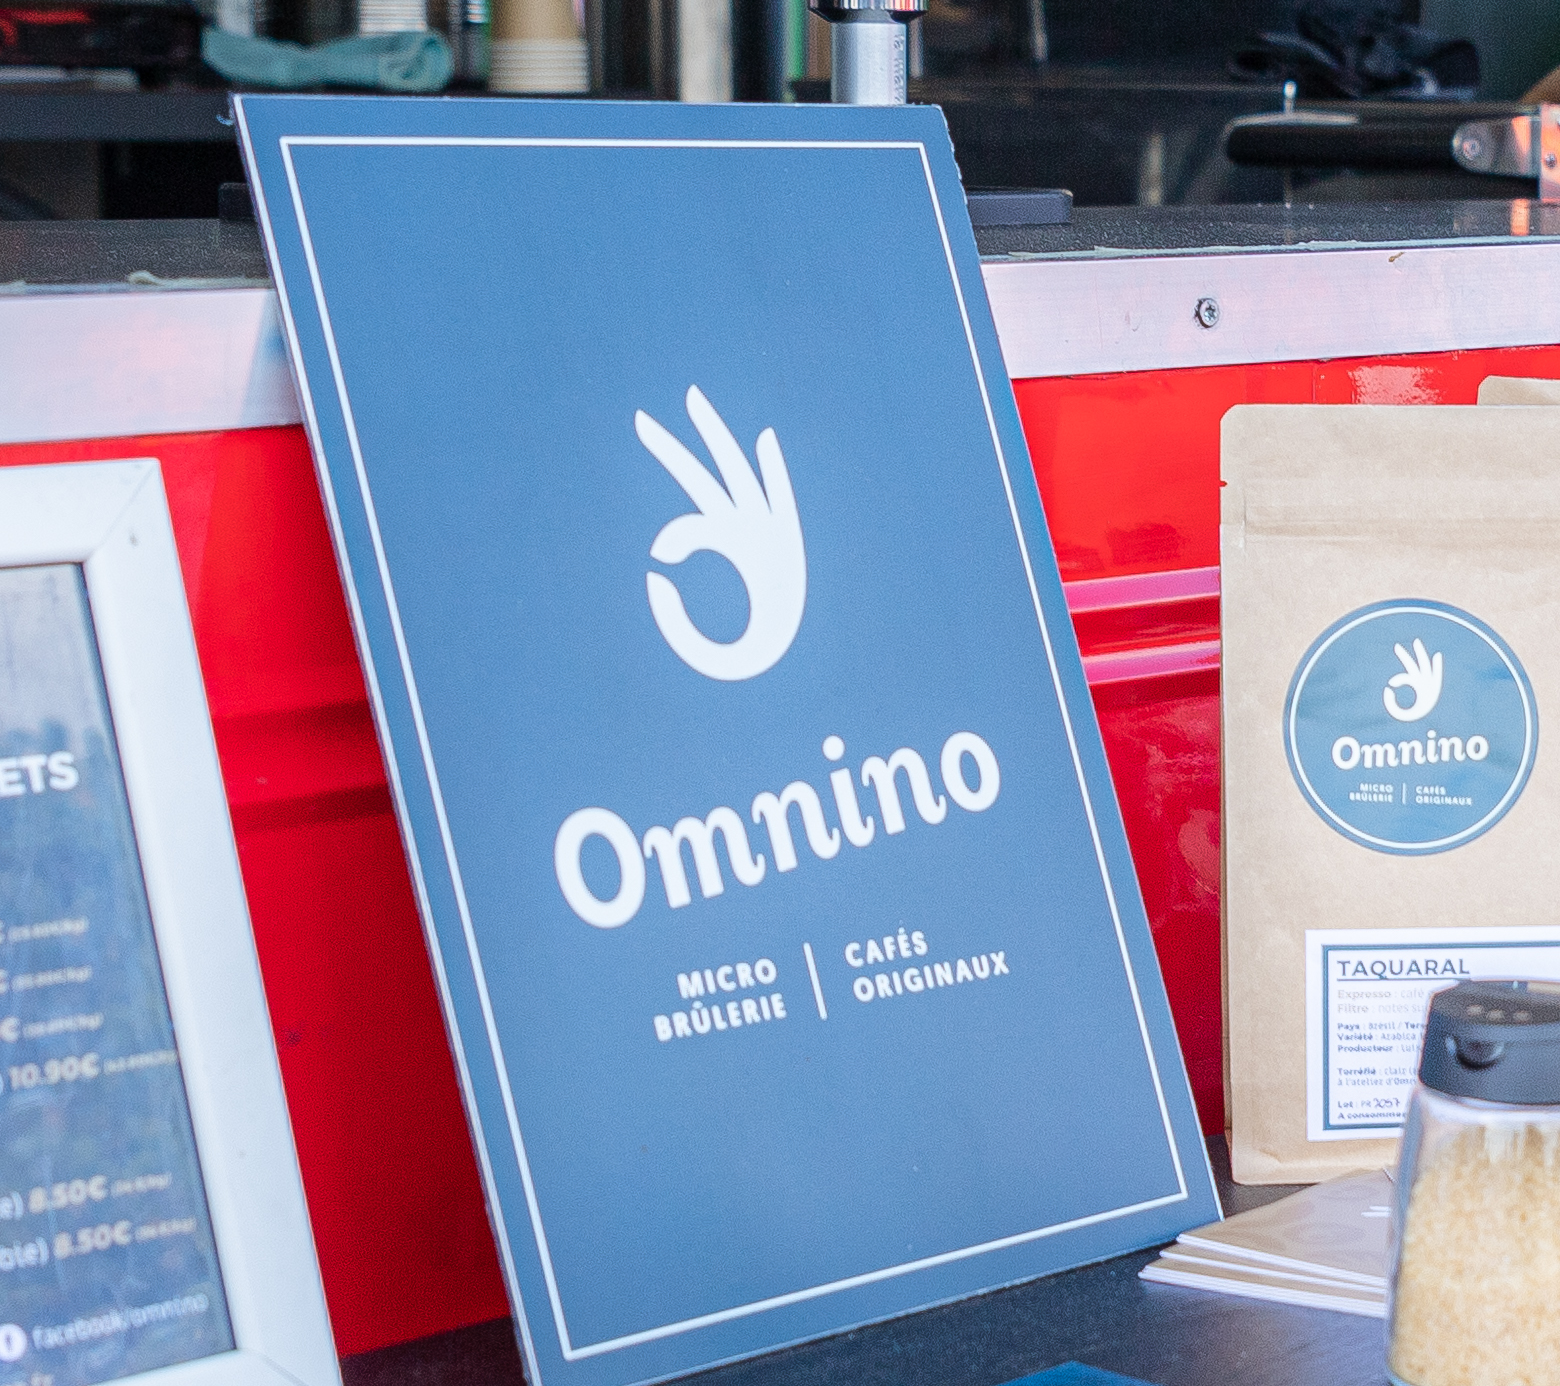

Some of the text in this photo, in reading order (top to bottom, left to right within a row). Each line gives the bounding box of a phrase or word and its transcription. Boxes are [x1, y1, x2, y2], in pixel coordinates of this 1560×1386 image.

[1332, 729, 1489, 770] Omnino
[1359, 782, 1394, 793] MICRO
[554, 732, 1001, 929] Omnino
[844, 926, 929, 968] CAFÉS
[677, 958, 778, 999] MICRO
[852, 949, 1011, 1002] ORIGINAUX
[1337, 959, 1470, 980] TAQUARAL
[653, 991, 787, 1042] BRÛLERIE
[1338, 990, 1392, 1002] Expresso
